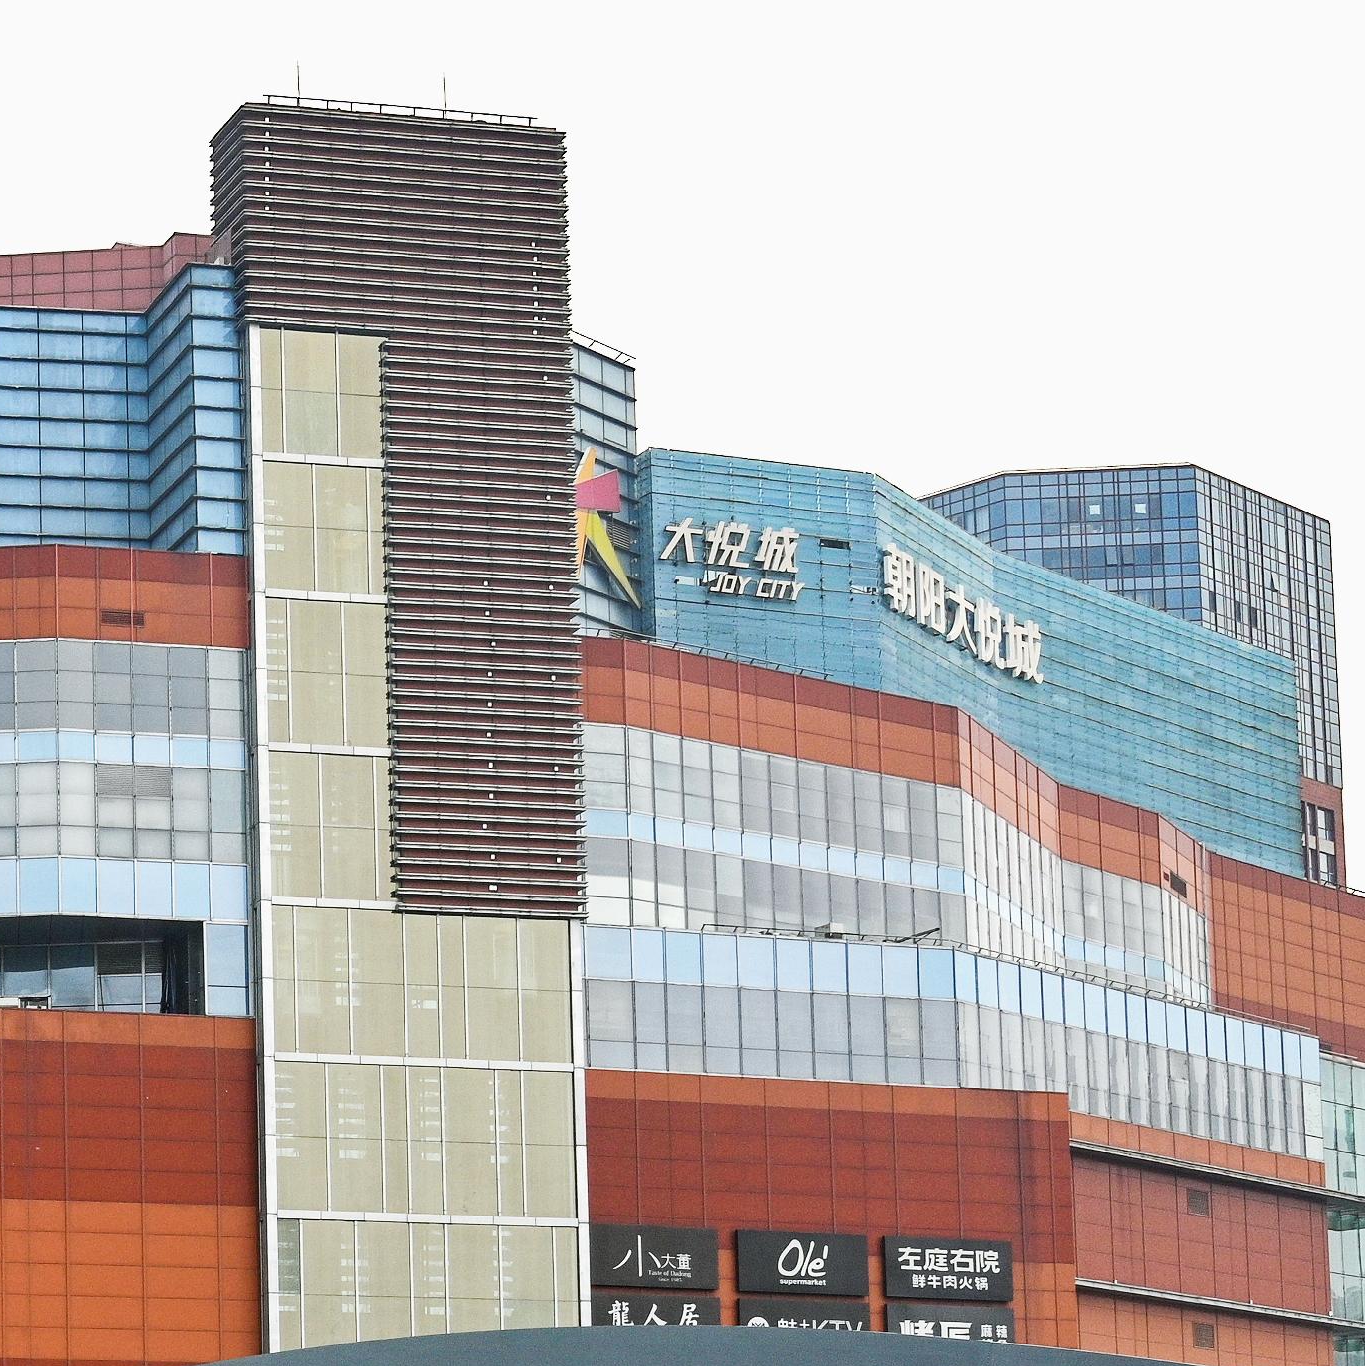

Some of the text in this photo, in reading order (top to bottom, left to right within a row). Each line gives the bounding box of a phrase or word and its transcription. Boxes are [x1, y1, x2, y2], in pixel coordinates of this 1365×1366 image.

[659, 517, 800, 574] 大悦城
[709, 572, 805, 601] JOY CITY
[882, 543, 1043, 684] 朝阳大悦城
[898, 1246, 1001, 1274] 左庭右院
[779, 1279, 827, 1287] supermarket
[912, 1274, 989, 1291] 鲜牛肉火锅
[980, 1324, 1008, 1338] 麻辣
